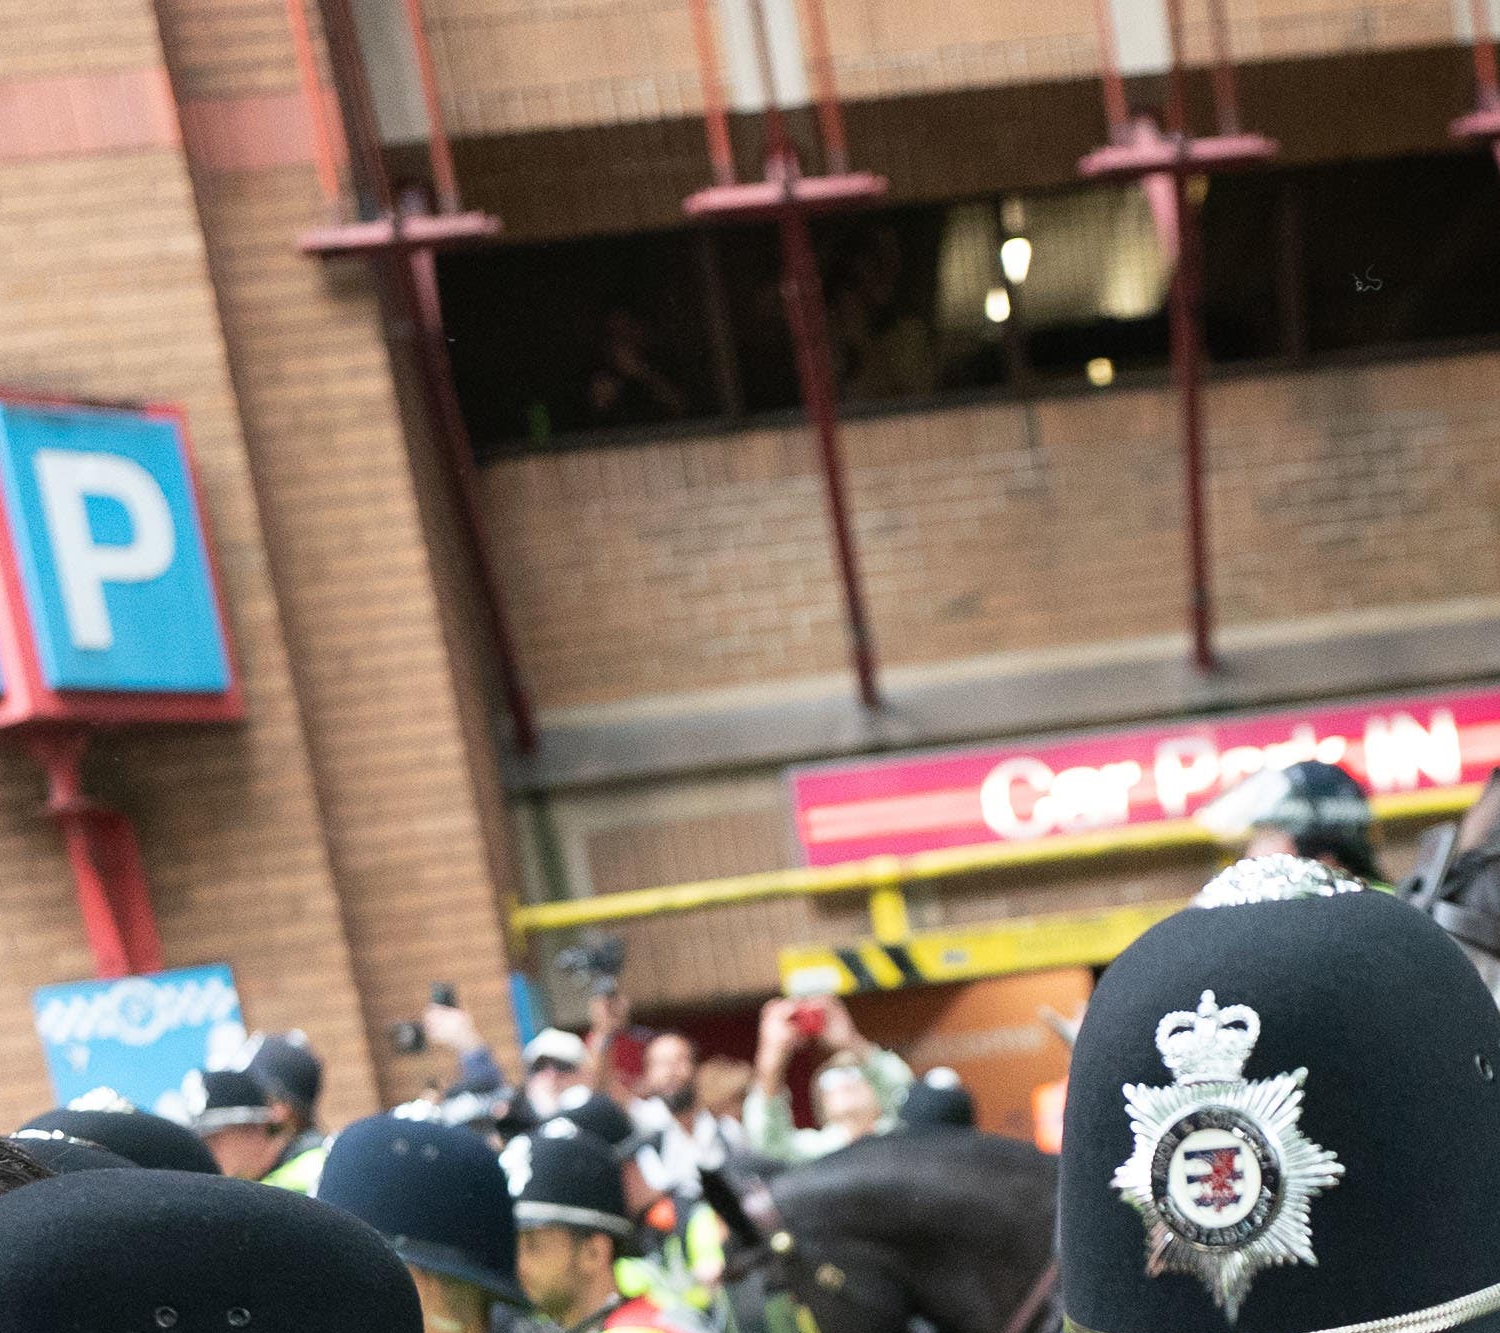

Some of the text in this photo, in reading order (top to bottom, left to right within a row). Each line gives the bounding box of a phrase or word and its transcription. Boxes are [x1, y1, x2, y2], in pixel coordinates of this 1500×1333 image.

[34, 448, 177, 652] P
[980, 756, 1141, 839] Car
[1363, 708, 1462, 792] IN
